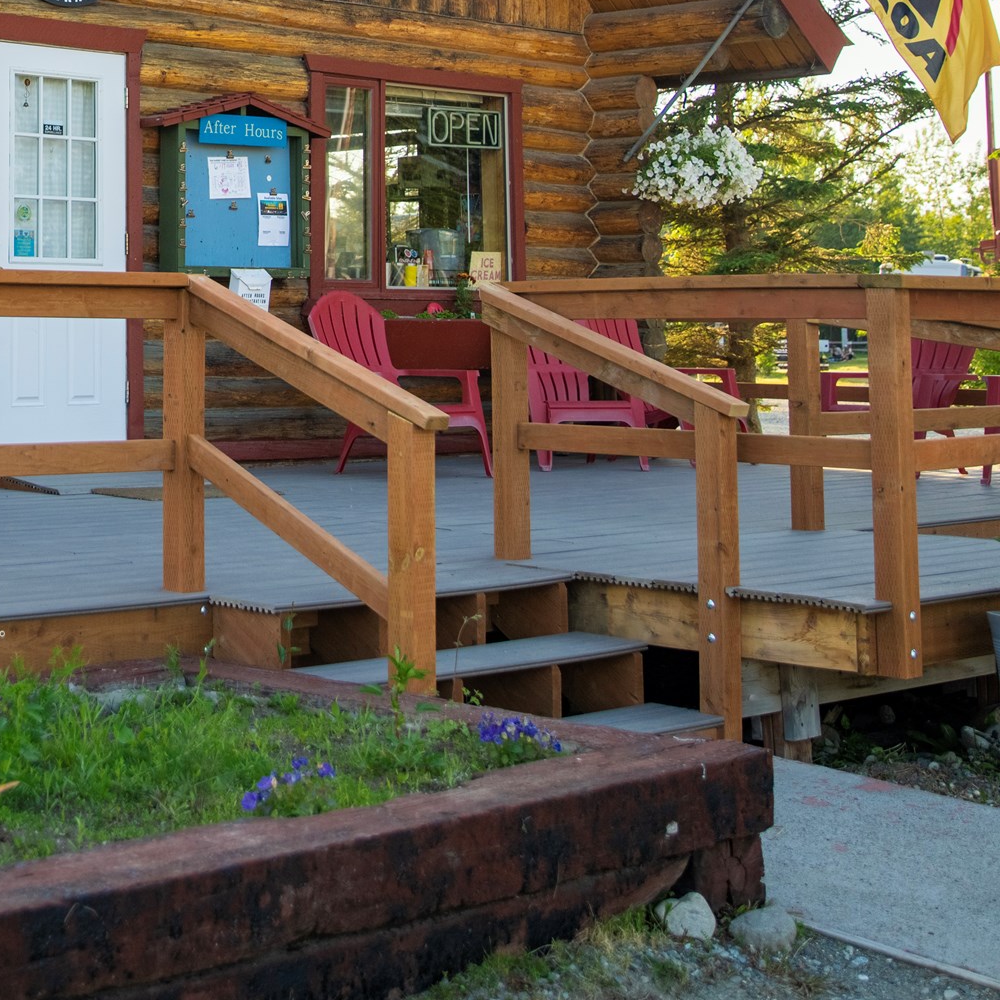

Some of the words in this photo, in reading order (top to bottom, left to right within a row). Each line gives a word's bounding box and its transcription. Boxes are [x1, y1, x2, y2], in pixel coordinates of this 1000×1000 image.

[203, 119, 237, 136] After
[244, 123, 284, 141] Hours
[432, 111, 498, 146] OPEN
[480, 257, 495, 269] ICE
[470, 269, 501, 281] CREAM
